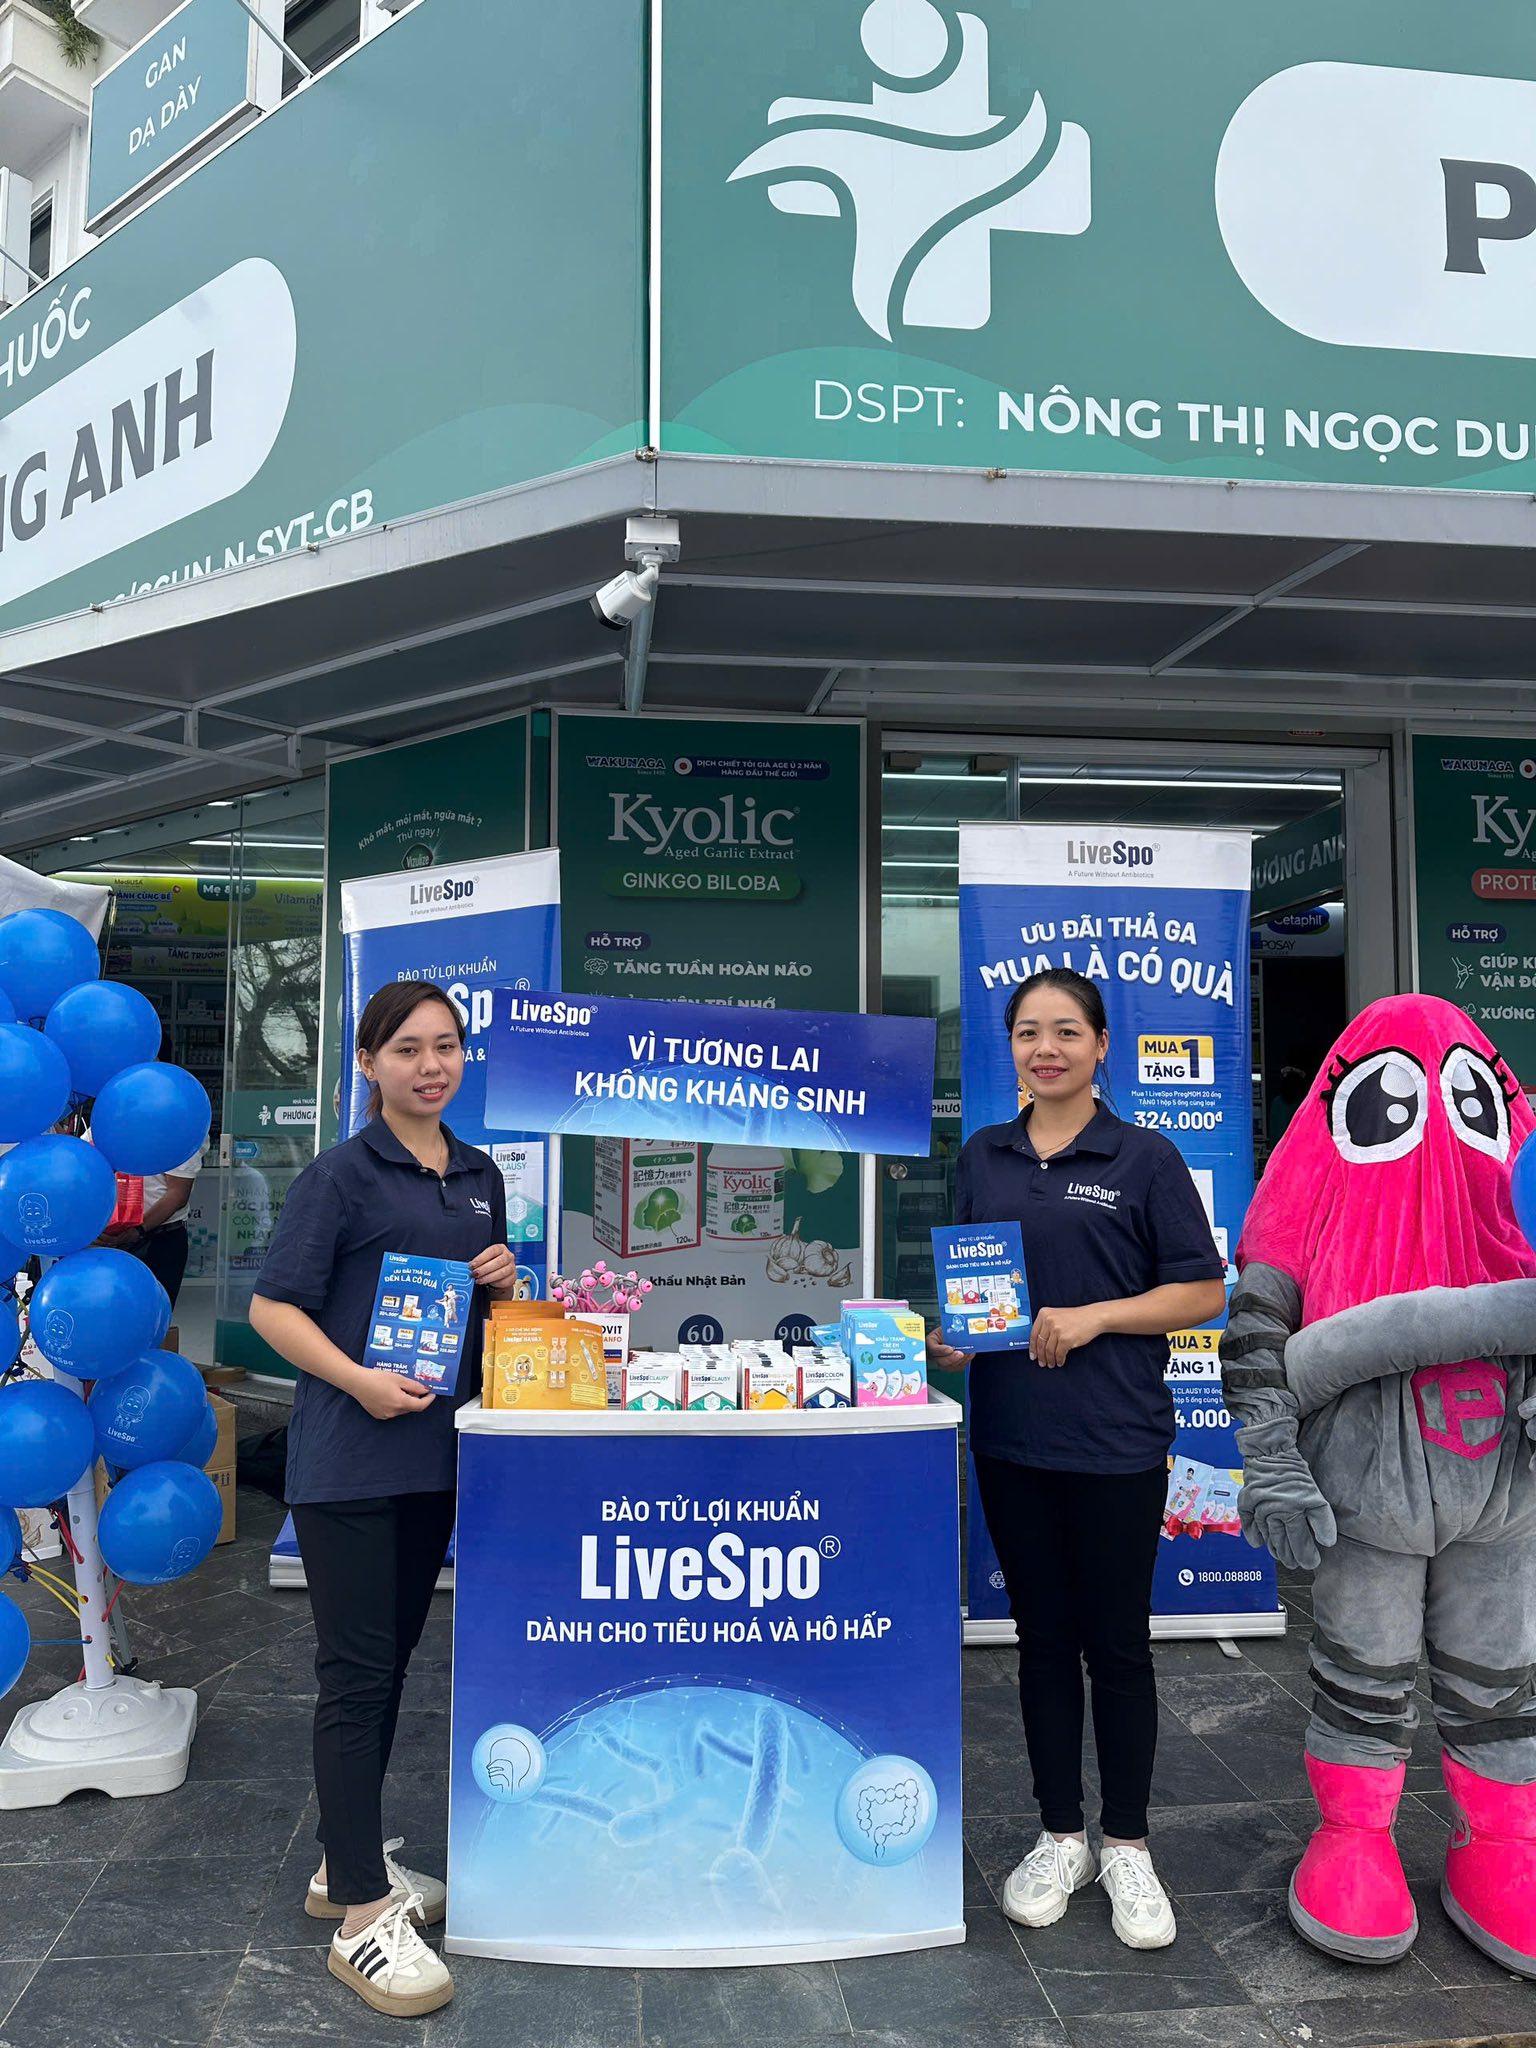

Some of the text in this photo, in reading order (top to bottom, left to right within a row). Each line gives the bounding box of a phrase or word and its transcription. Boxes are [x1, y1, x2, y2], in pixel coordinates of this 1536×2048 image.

[145, 37, 187, 89] GAN
[129, 75, 202, 155] DẠ DÀY
[814, 380, 1536, 463] DSPT: NÔNG THỊ NGỌC DU
[60, 348, 214, 520] ANH
[586, 756, 667, 770] WAKUNAGA
[718, 759, 741, 770] CHIẾT
[772, 762, 789, 771] AGE
[803, 761, 822, 771] NĂM
[1440, 758, 1515, 773] WAKUNAGA
[721, 768, 745, 778] HÀNG
[665, 846, 795, 860] Aged Garlic Extract
[1252, 848, 1306, 891] ƯƠNG
[203, 884, 220, 897] Mẹ
[623, 872, 782, 891] GINKGO BILOBA
[1021, 911, 1198, 945] ƯU ĐÃI THẢ GA
[1452, 924, 1499, 943] HỖ TRỢ
[590, 932, 642, 950] HỖ TRỢ
[397, 955, 497, 984] BÀO TỬ LỢI KHUẨN
[613, 954, 813, 977] TĂNG TUẦN HOÀN NÃO
[1480, 953, 1519, 969] GIÚP
[1117, 946, 1163, 984] CÓ
[1170, 960, 1235, 1006] QUÀ
[1480, 971, 1516, 991] VẬN
[1480, 1007, 1535, 1020] XƯƠNG
[515, 1026, 591, 1038] Future Without Antibiotics
[477, 1051, 487, 1062] &
[628, 1030, 820, 1073] VÌ TƯƠNG LAI
[1144, 1038, 1199, 1079] MUA 1
[1143, 1062, 1186, 1082] TẶNG
[575, 1069, 867, 1115] KHÔNG KHÁNG SINH
[1149, 1091, 1173, 1099] LiveSpo
[722, 1174, 771, 1193] Kyolic
[686, 1275, 717, 1289] Nhật
[720, 1273, 746, 1287] Bản
[687, 1323, 715, 1343] 60
[1202, 1335, 1212, 1350] 3
[1207, 1361, 1215, 1374] 1
[107, 1427, 137, 1444] LiveSpo
[602, 1490, 820, 1528] BÀO TỬ LỢI KHUẨN
[1197, 1570, 1263, 1584] 1800.088808
[526, 1611, 893, 1643] DÀNH CHO TIÊU HOÁ VÀ HÔ HẤP
